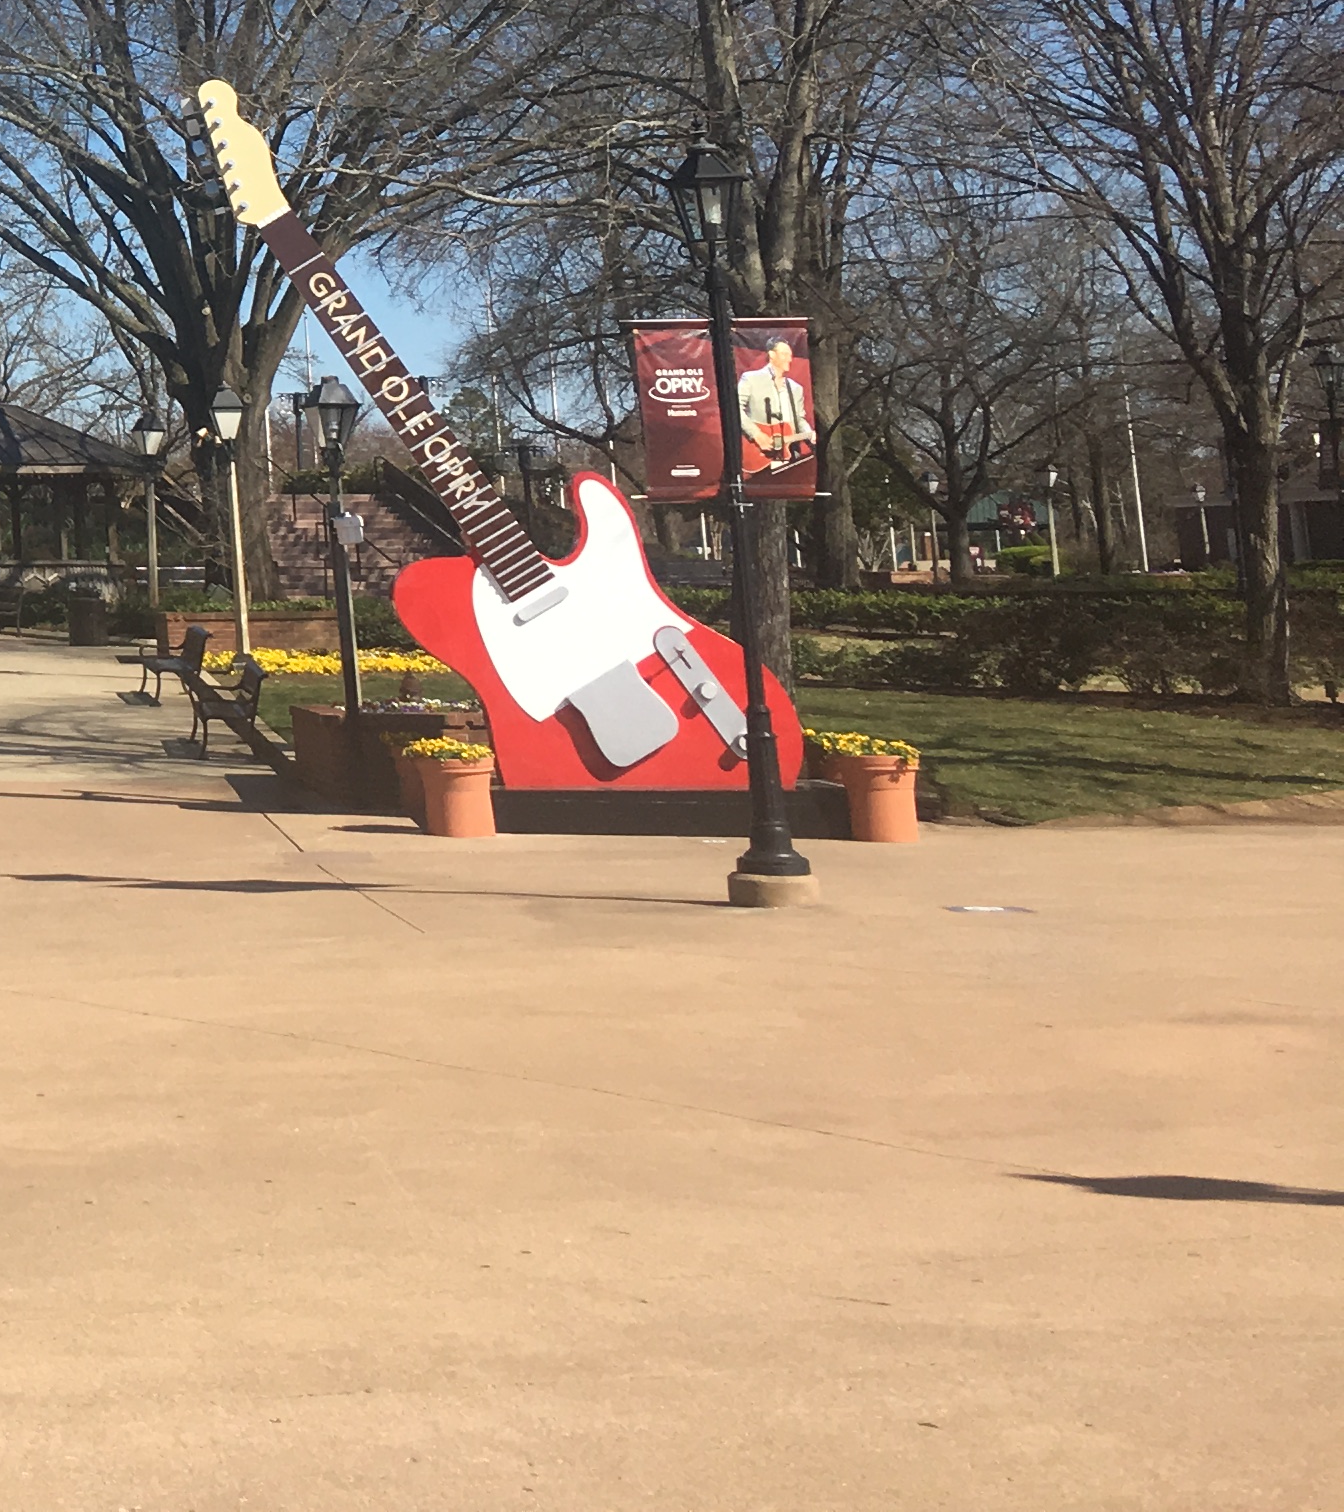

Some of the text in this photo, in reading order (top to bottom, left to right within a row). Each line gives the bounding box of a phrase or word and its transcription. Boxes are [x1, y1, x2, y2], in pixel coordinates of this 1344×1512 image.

[655, 368, 704, 376] GRAND OLE
[308, 272, 492, 510] GRAND OLE OPRY
[655, 377, 704, 394] OPRY
